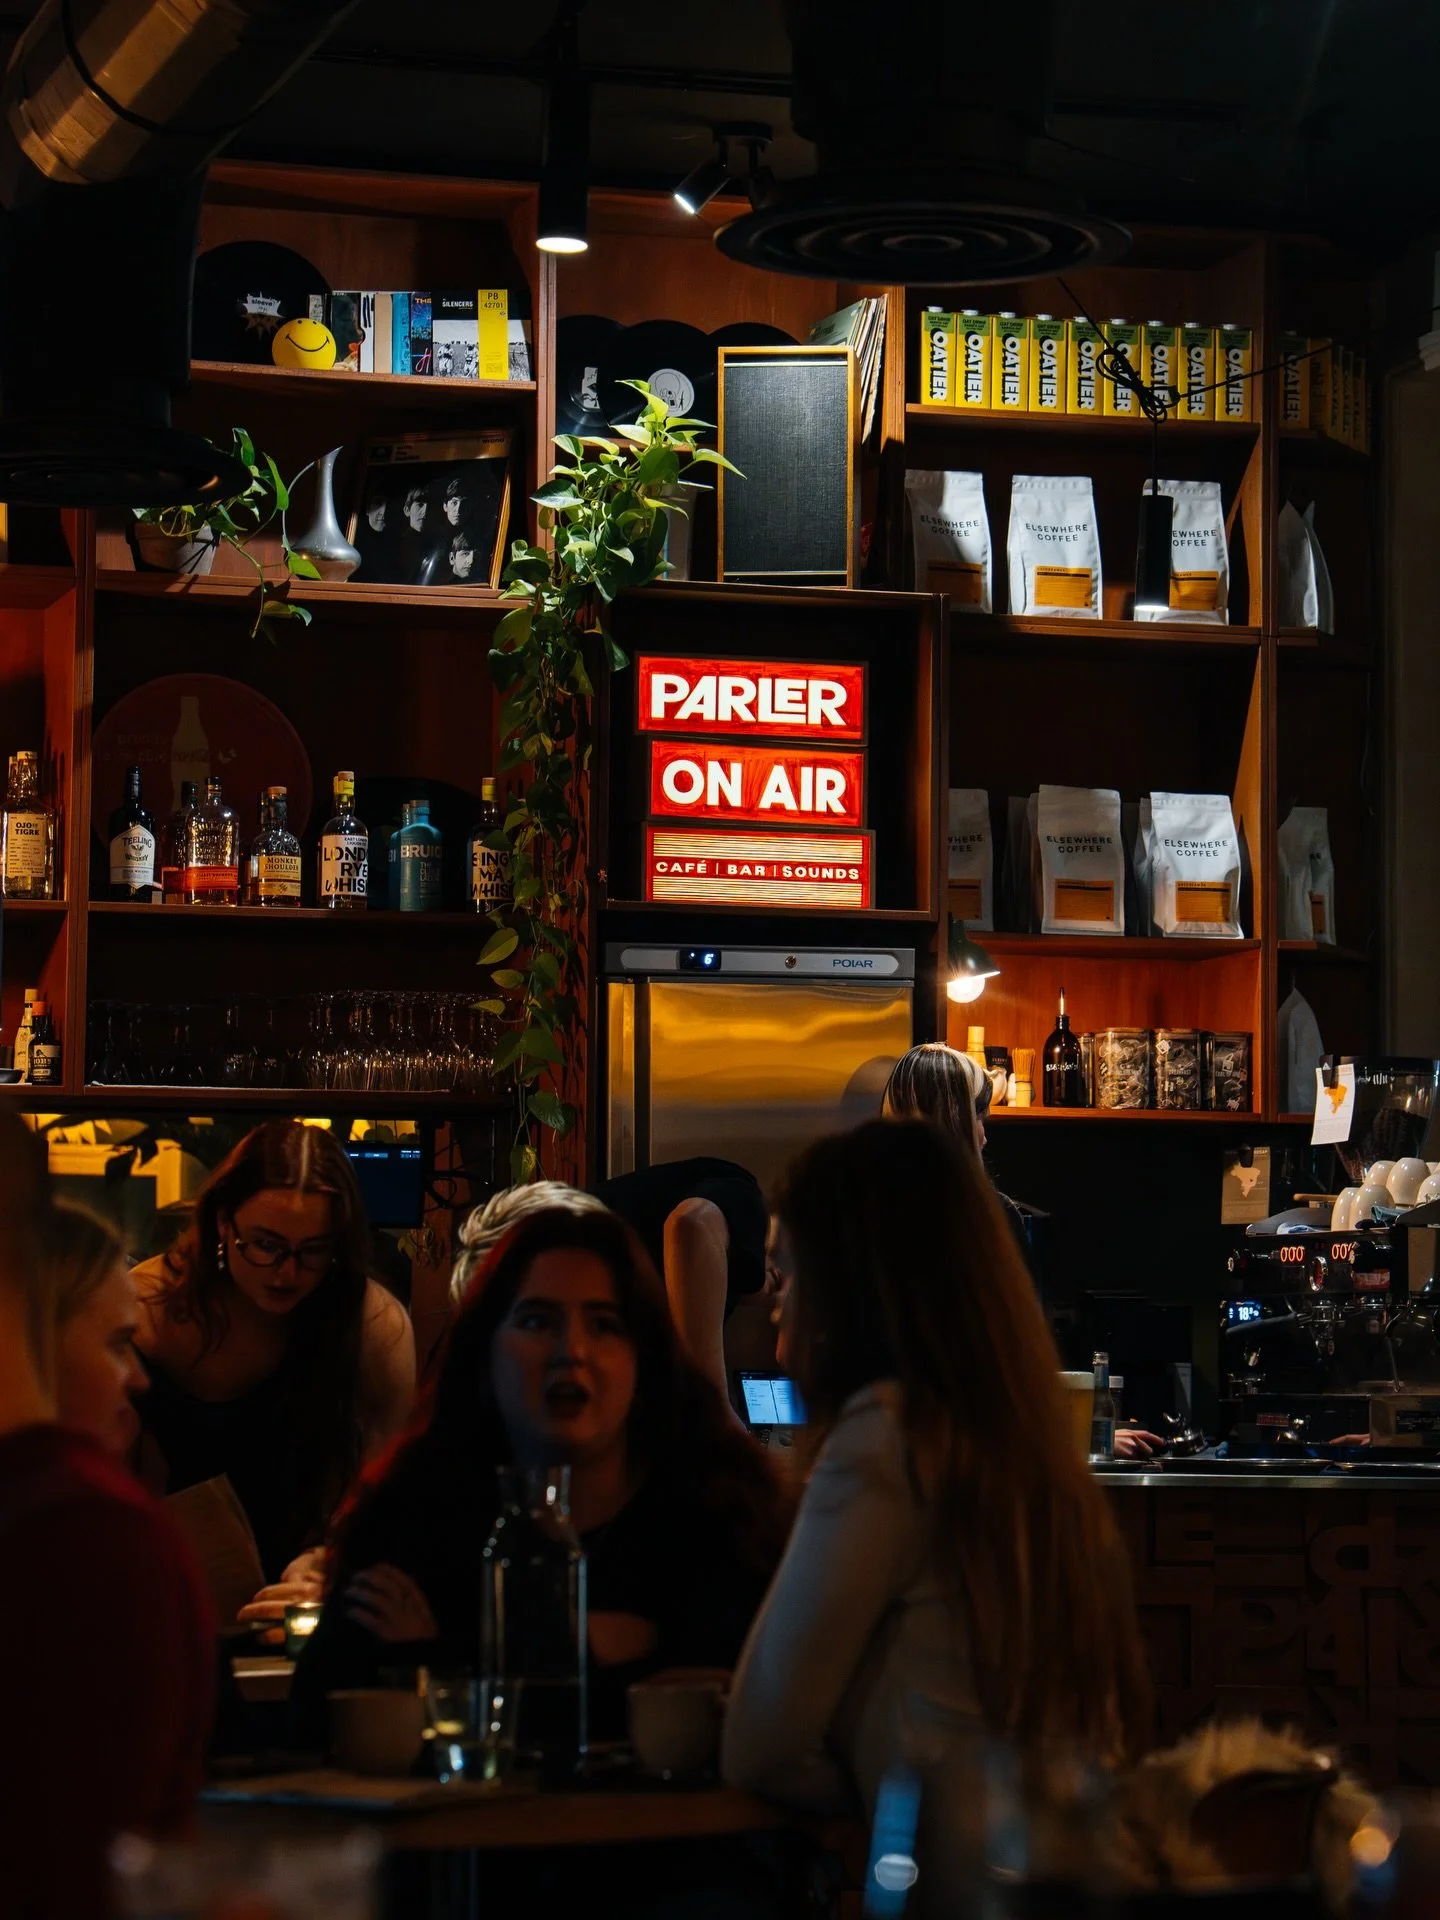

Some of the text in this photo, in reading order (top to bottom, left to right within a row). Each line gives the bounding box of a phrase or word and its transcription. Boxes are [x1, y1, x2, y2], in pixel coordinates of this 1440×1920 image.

[487, 292, 499, 300] PB
[931, 330, 948, 400] OATIER
[966, 333, 984, 403] OATIER
[1004, 336, 1021, 406] OATIER
[1041, 338, 1058, 409] OATIER
[1079, 340, 1096, 410] OATIER
[920, 514, 980, 528] ELSEWHERE
[1025, 523, 1089, 533] ELSEWHERE
[931, 526, 970, 538] COFFEE
[1037, 533, 1079, 542] COFFEE
[650, 673, 848, 726] PARLER
[662, 759, 848, 814] ON AIR
[15, 828, 40, 836] TIGRE
[122, 836, 153, 848] TEELING
[1046, 835, 1113, 845] ELSEWHERE
[1164, 839, 1229, 849] ELSEWHERE
[1058, 845, 1103, 853] COFFEE
[1176, 849, 1219, 857] COFFEE
[341, 862, 368, 877] RYE
[655, 859, 860, 880] CAFÉ BAR SOUNDS
[471, 882, 511, 898] WHIS
